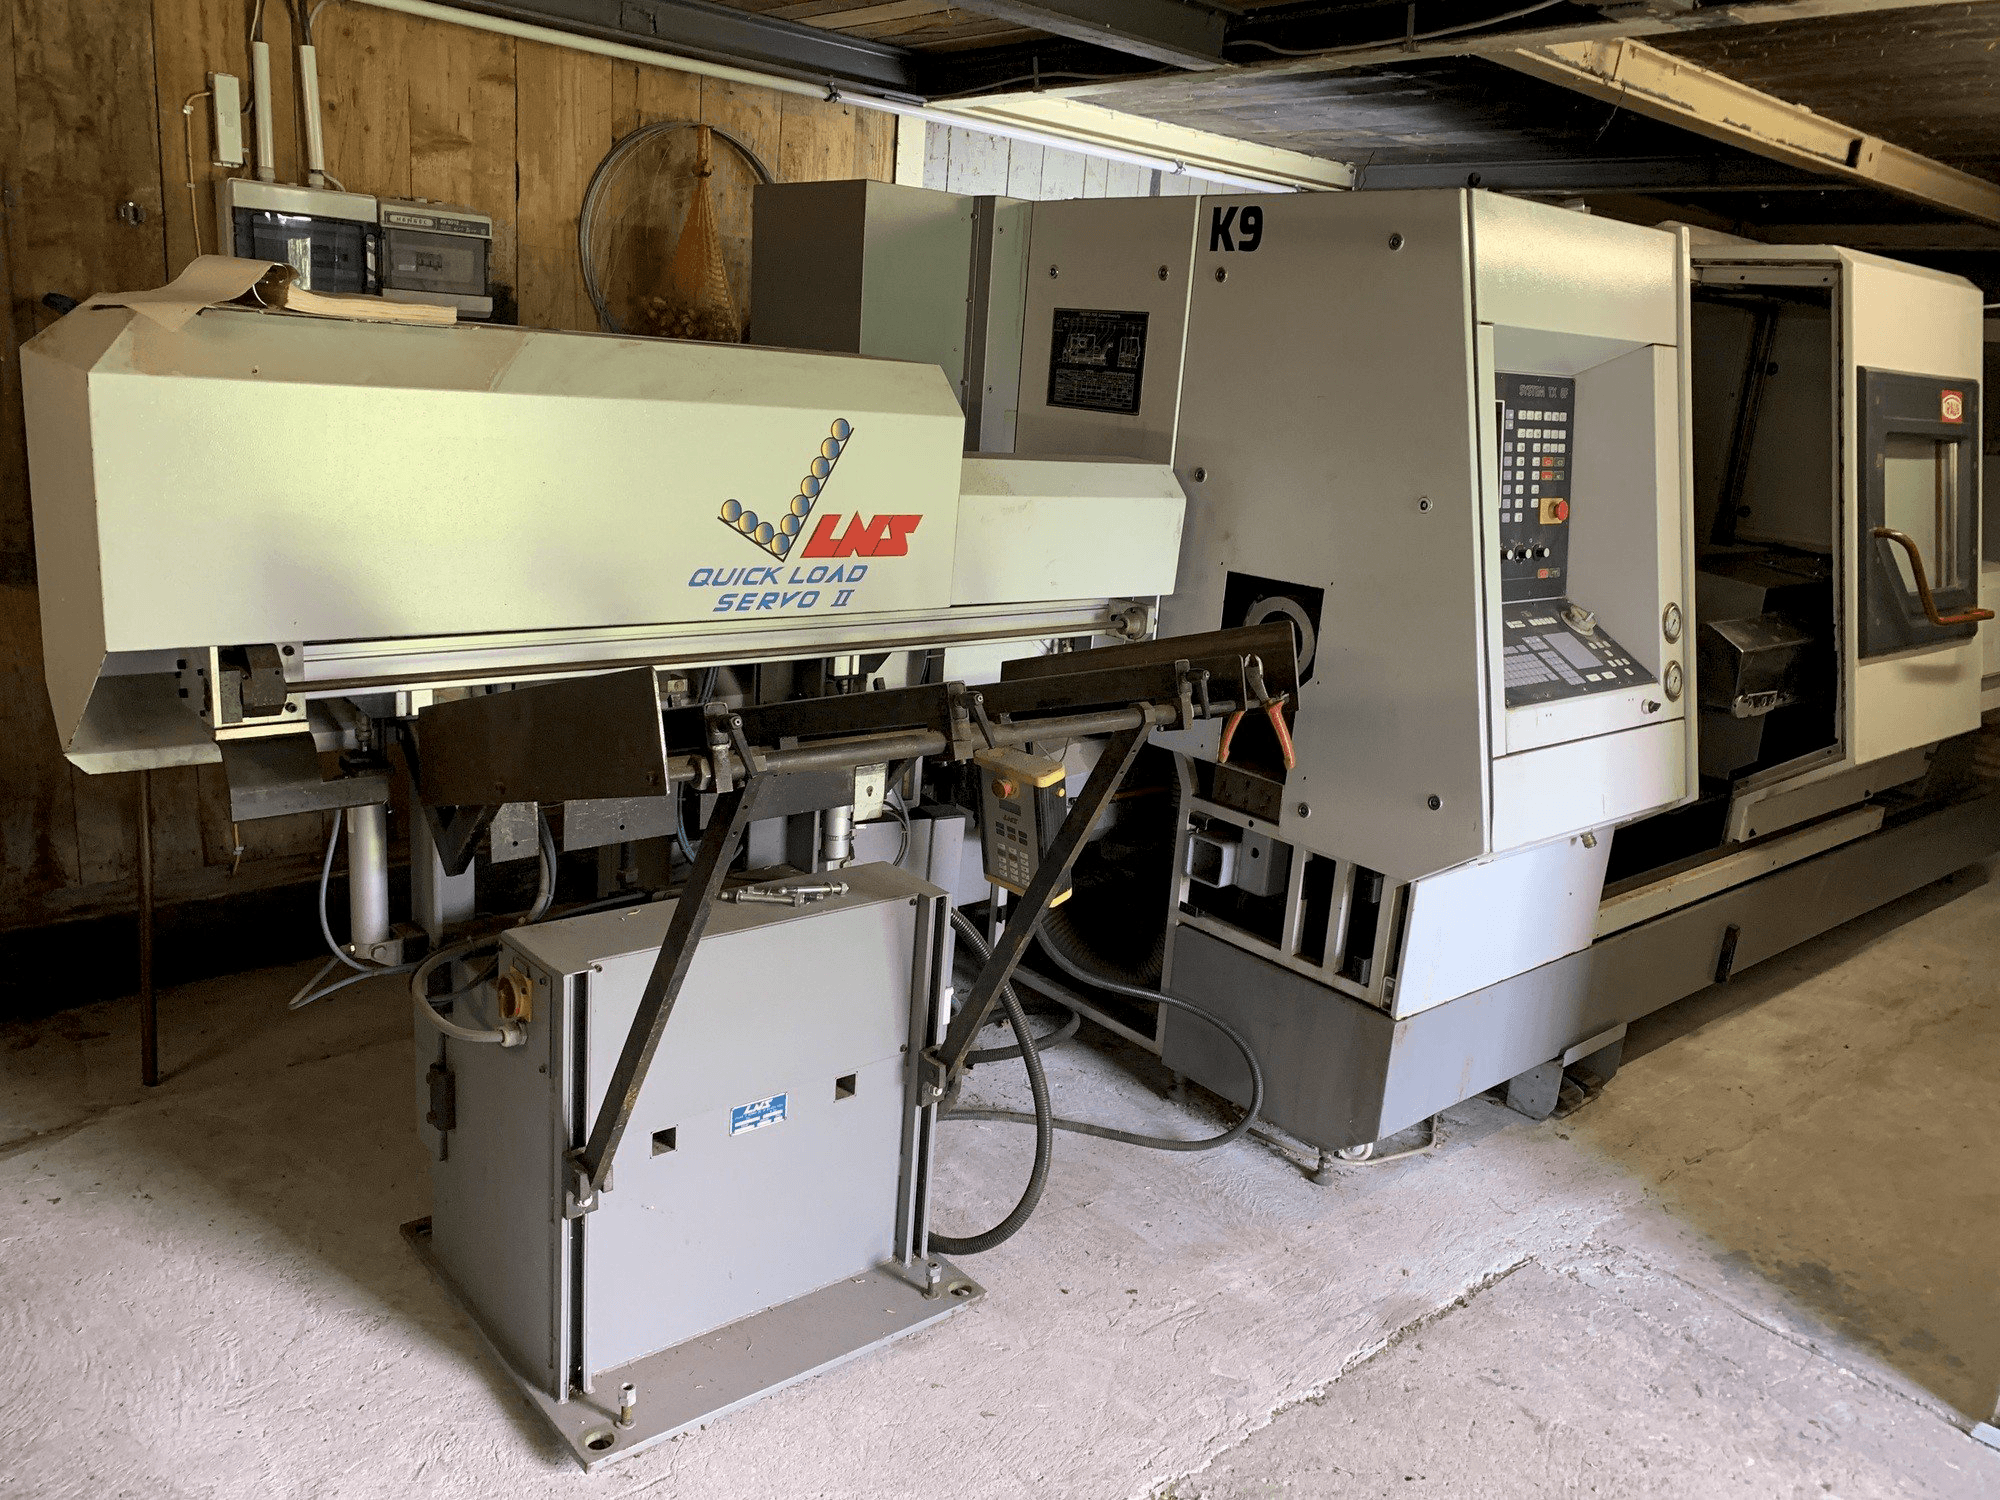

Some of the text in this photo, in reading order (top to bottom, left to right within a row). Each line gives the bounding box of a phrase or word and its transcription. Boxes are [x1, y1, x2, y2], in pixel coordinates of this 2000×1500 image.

[1209, 206, 1263, 252] K9
[1519, 384, 1546, 398] SYSTEM
[799, 510, 923, 558] LNS
[688, 564, 868, 587] QUICK LOAD
[712, 590, 820, 612] SERVO
